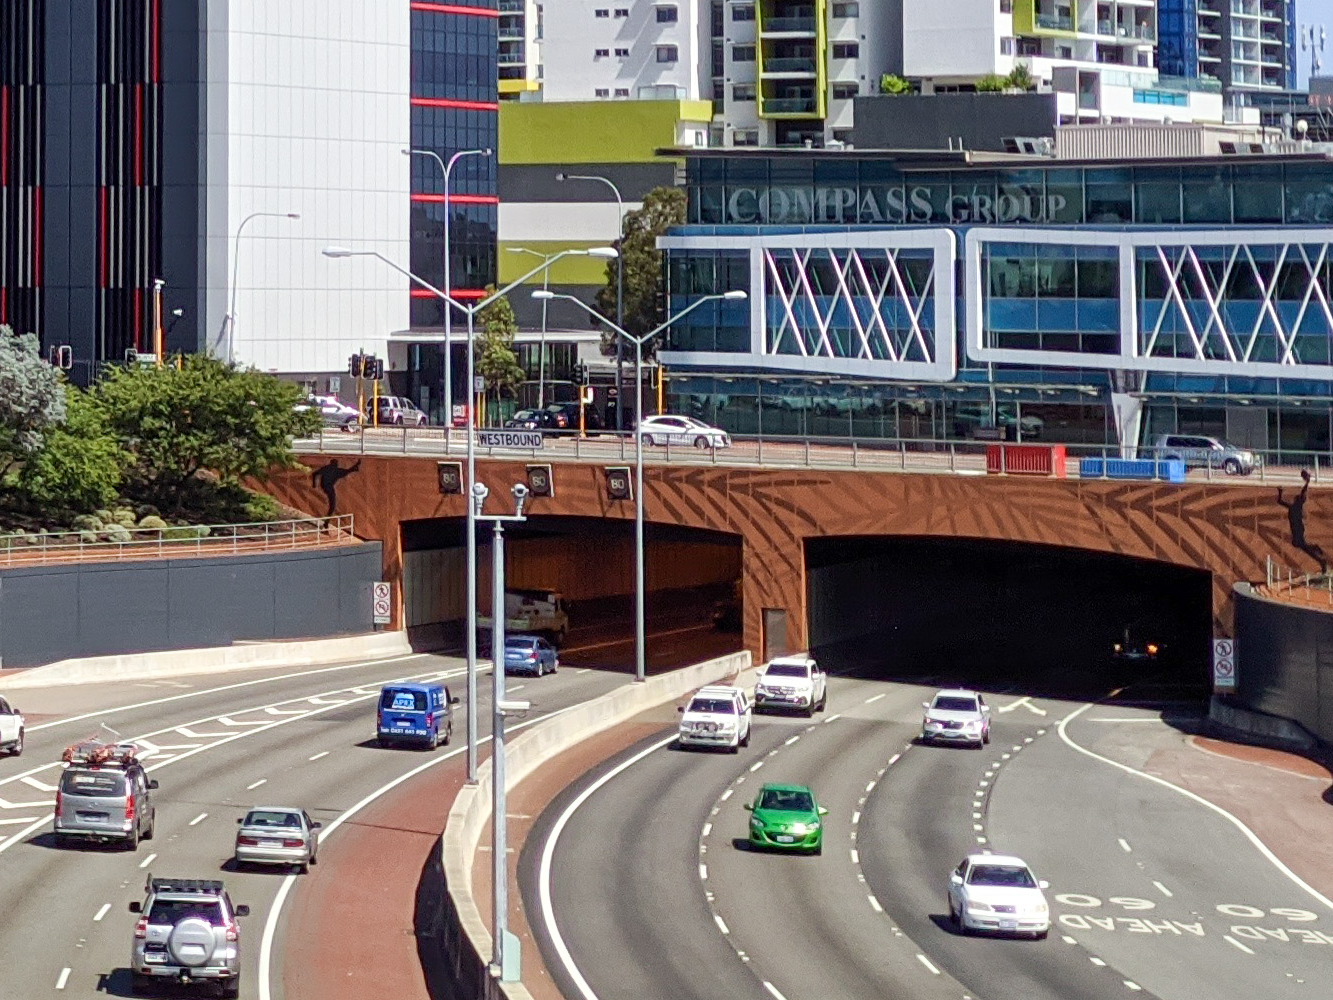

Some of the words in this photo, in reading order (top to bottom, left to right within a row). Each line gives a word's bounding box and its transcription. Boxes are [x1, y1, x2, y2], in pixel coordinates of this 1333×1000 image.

[727, 186, 933, 224] COMPASS
[944, 193, 1067, 224] GROUP
[478, 433, 542, 447] WESTBOUND
[1055, 893, 1156, 910] 60
[1216, 904, 1318, 921] 60
[1058, 914, 1206, 937] AHEAD
